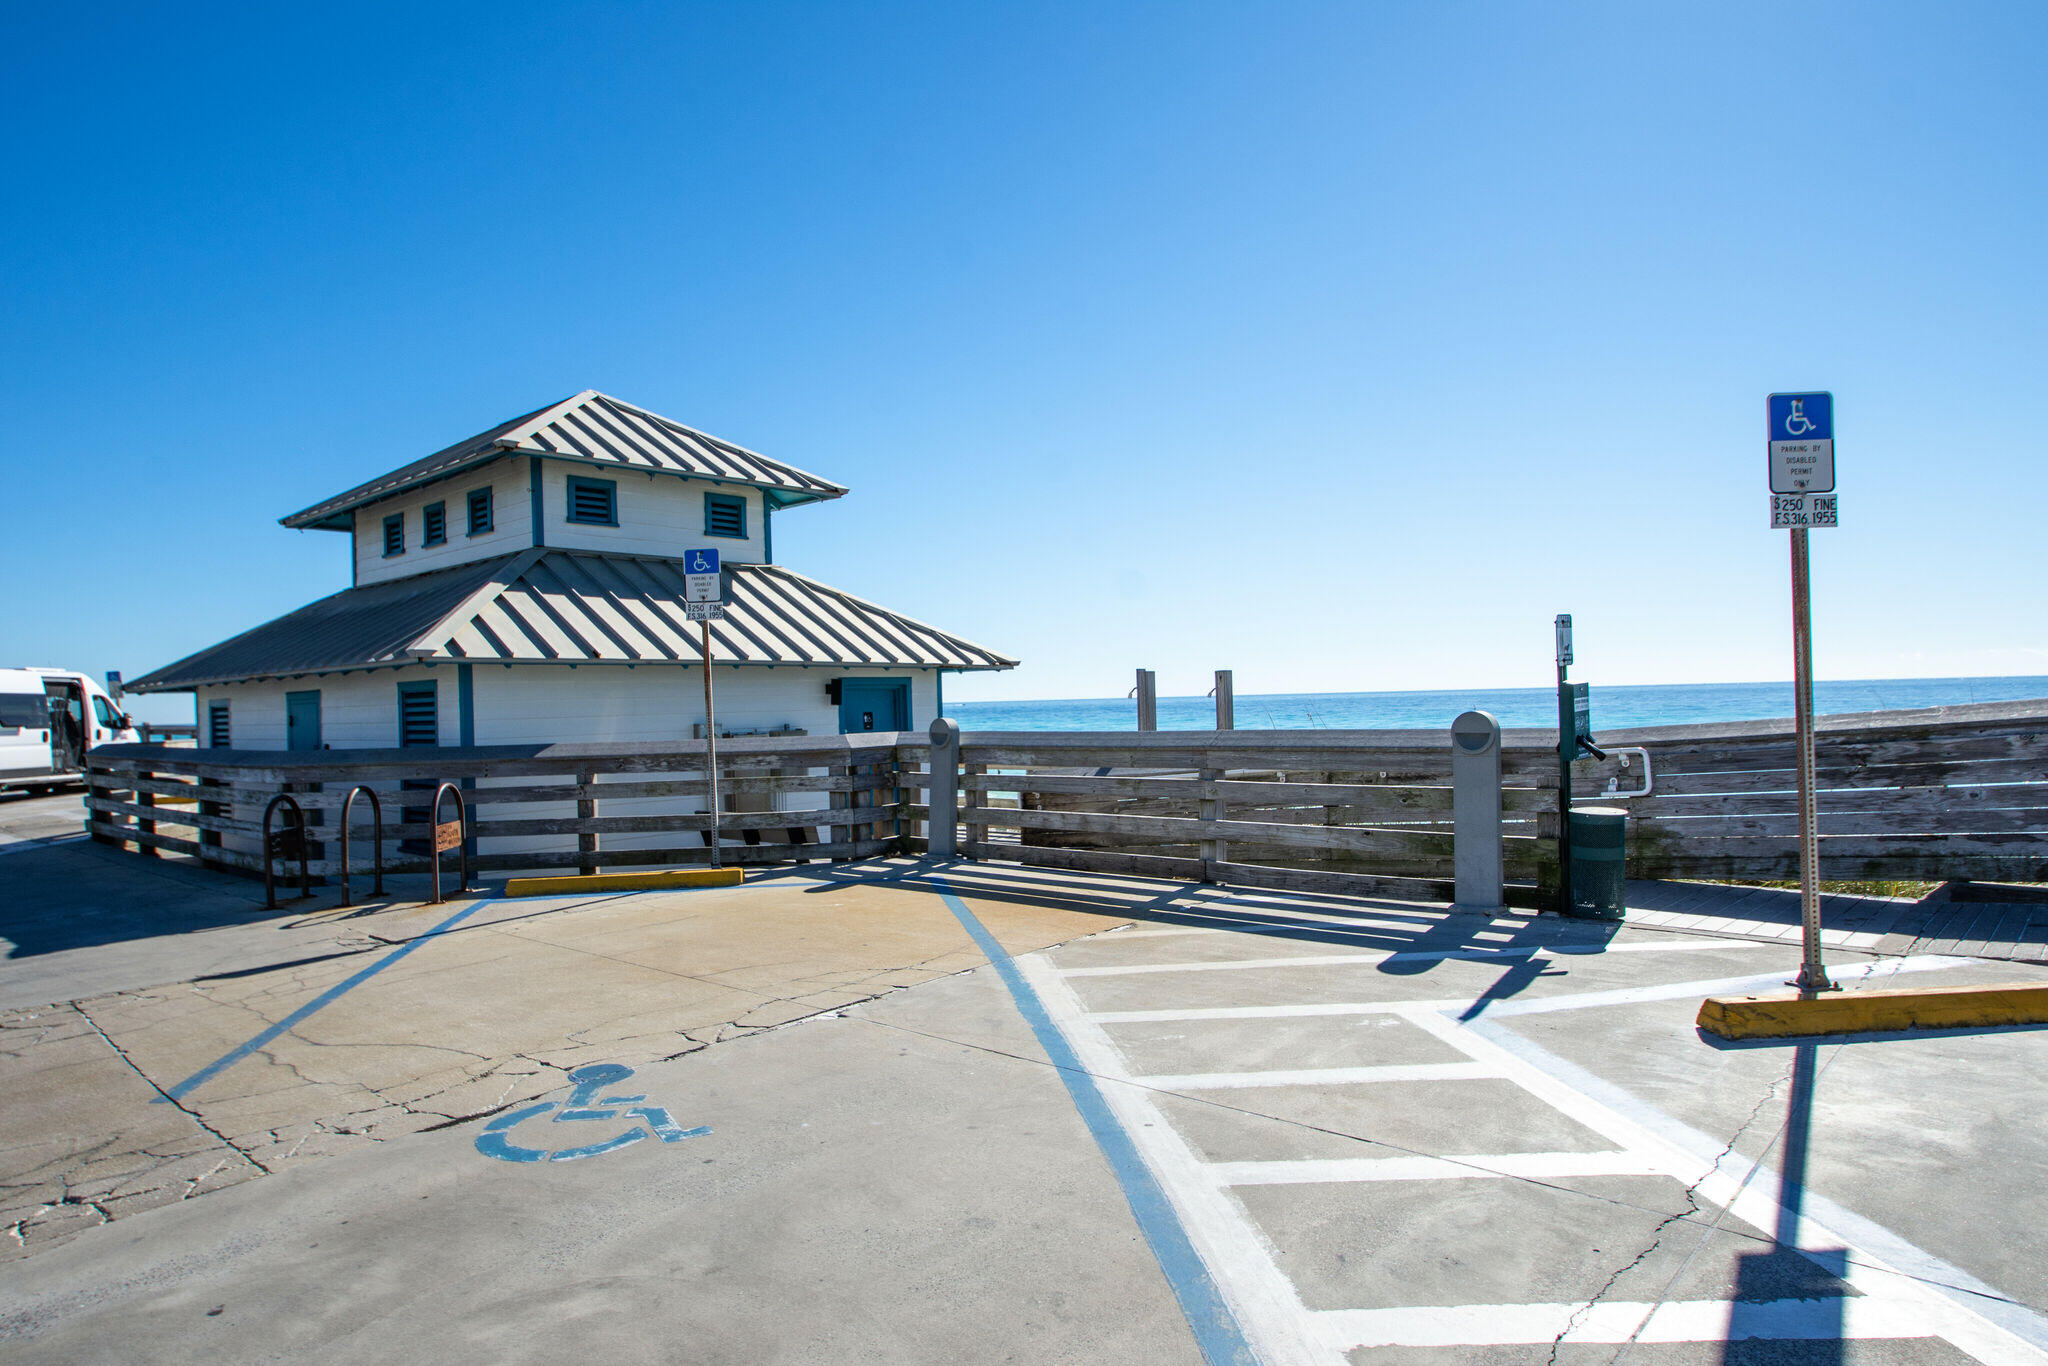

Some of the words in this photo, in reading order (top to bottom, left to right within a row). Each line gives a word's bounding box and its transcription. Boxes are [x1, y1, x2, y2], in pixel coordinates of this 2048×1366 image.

[1780, 444, 1808, 453] PARKING
[1812, 444, 1821, 452] BY
[1785, 456, 1817, 464] DISABLED
[1790, 467, 1812, 475] PERMIT
[1774, 496, 1803, 511] $250
[1814, 498, 1837, 511] FINE
[688, 604, 705, 612] $250
